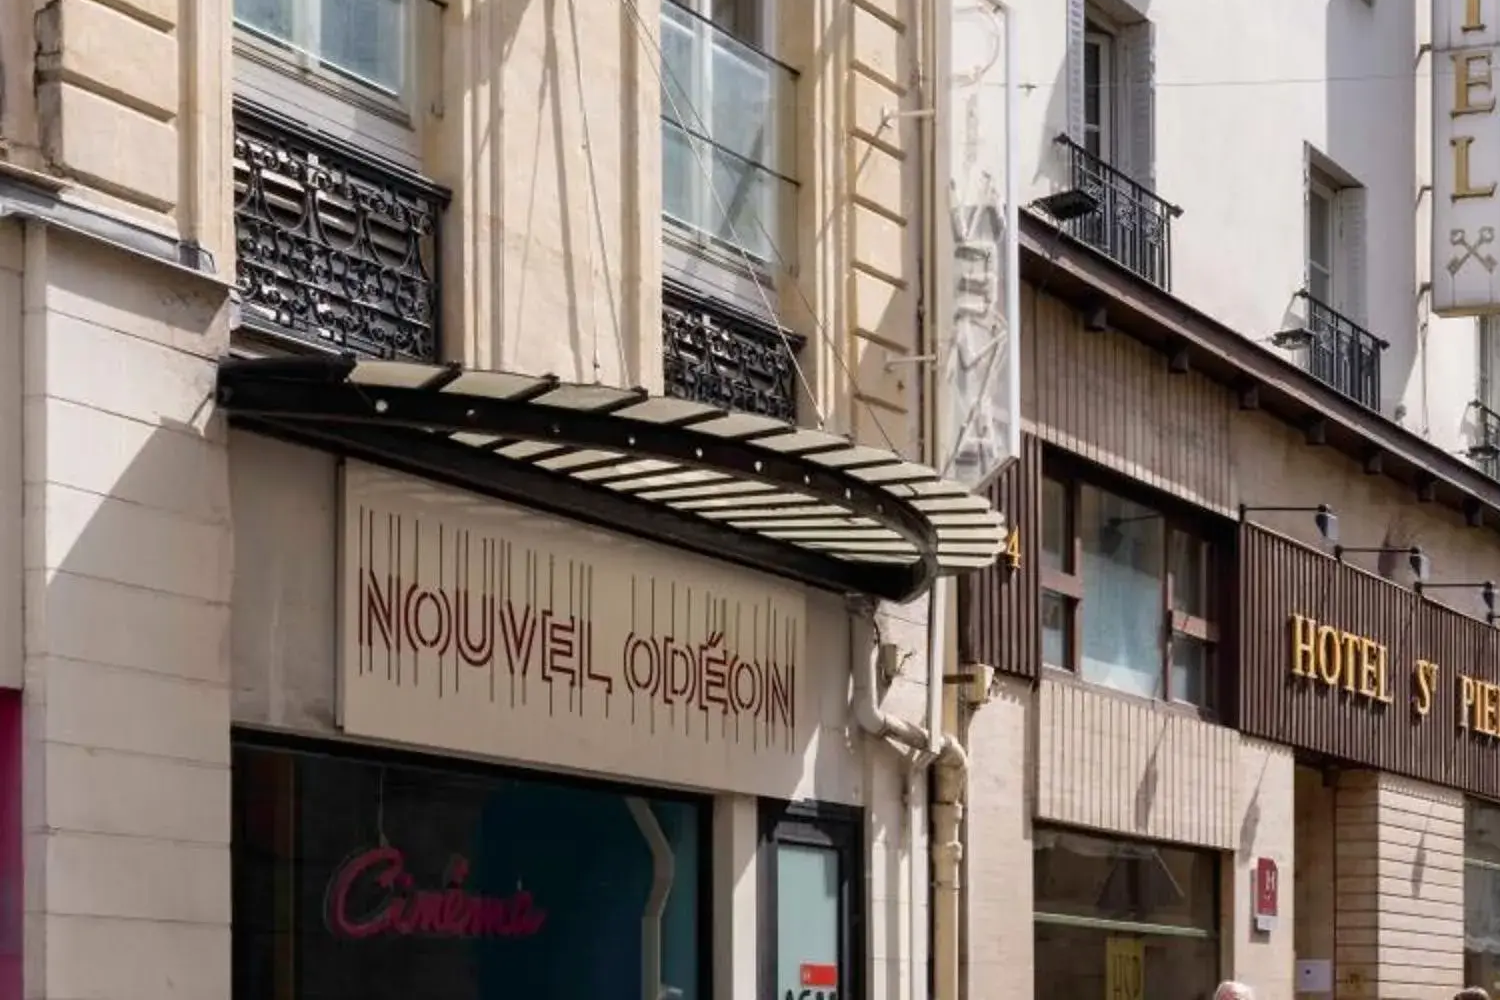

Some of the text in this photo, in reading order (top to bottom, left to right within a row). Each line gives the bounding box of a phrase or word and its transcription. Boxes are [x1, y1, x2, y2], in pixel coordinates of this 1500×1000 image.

[1007, 523, 1021, 569] 4
[358, 567, 797, 729] NOUVEL ODÉON
[1290, 613, 1394, 704] HOTEL
